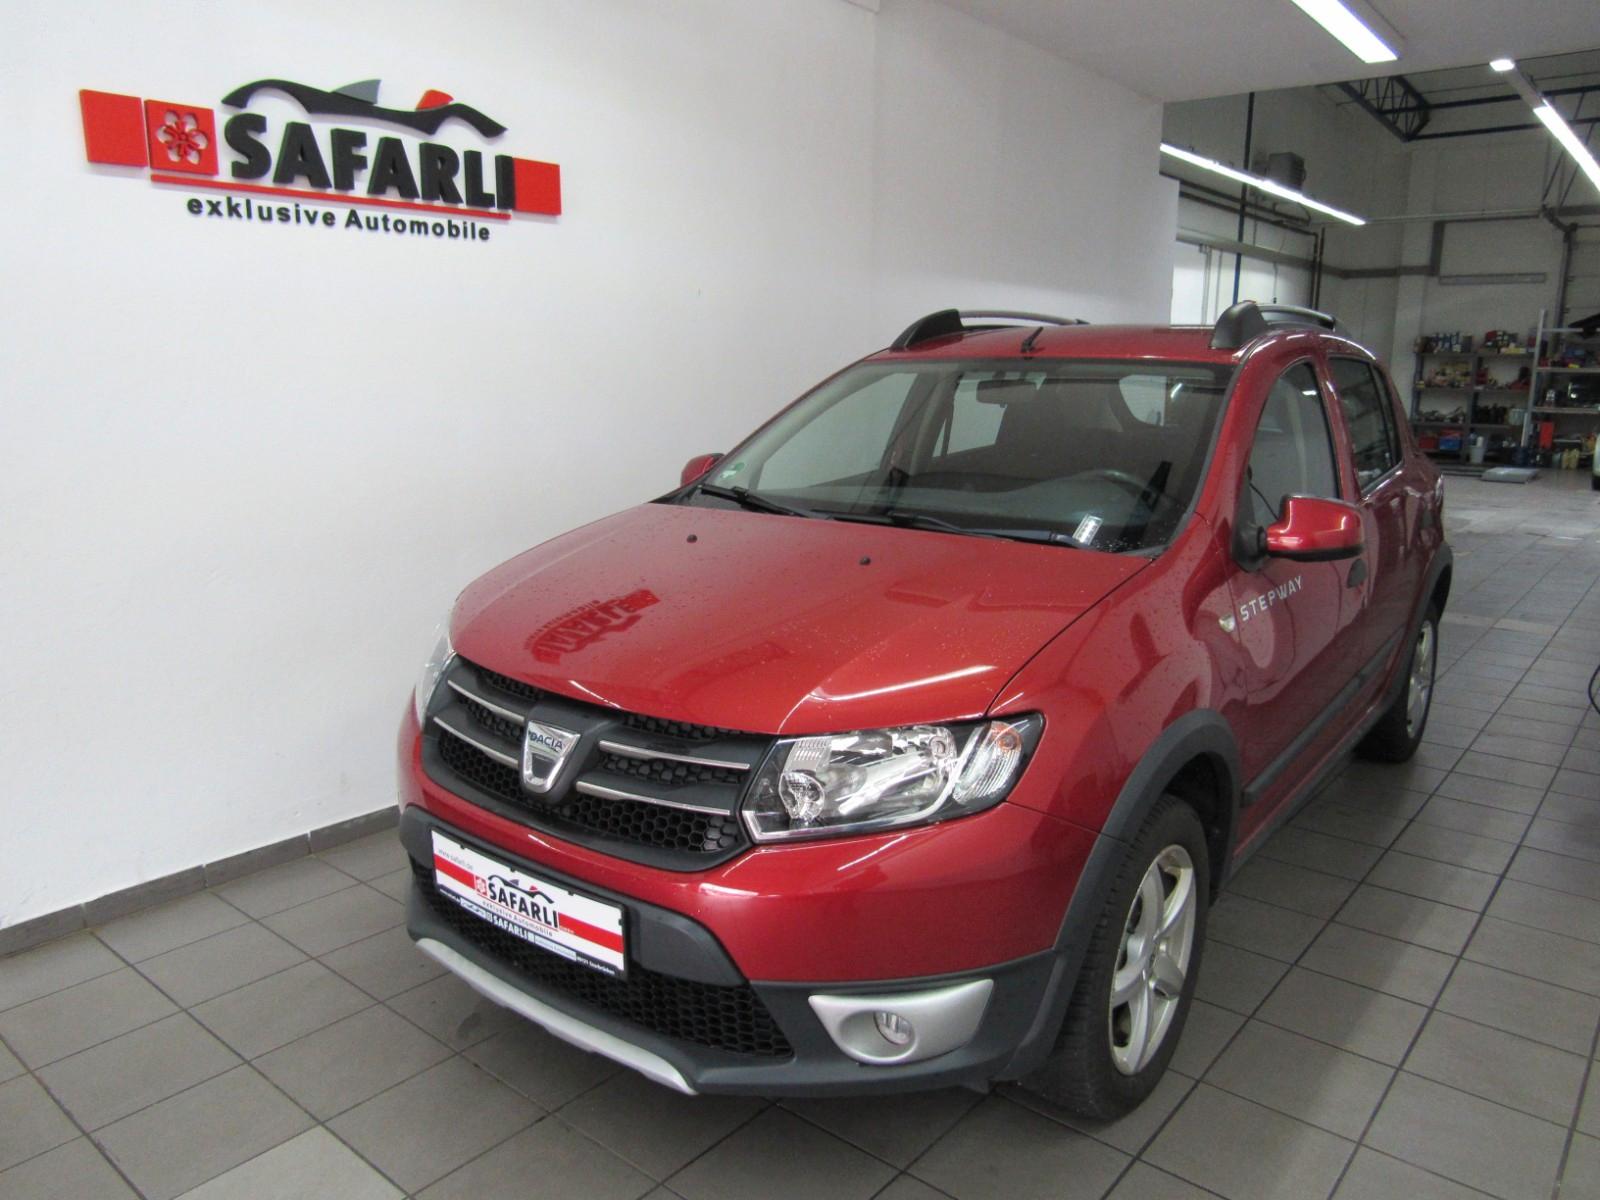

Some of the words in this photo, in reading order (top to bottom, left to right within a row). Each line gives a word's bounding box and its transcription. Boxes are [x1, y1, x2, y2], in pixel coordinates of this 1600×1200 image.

[223, 111, 515, 210] SAFARLI
[187, 197, 336, 226] exklusive
[345, 209, 490, 241] Automobile
[1240, 575, 1302, 621] STEPWAY
[530, 732, 563, 750] DACIA
[488, 882, 558, 928] SAFARLI
[493, 914, 528, 939] SAFARLI
